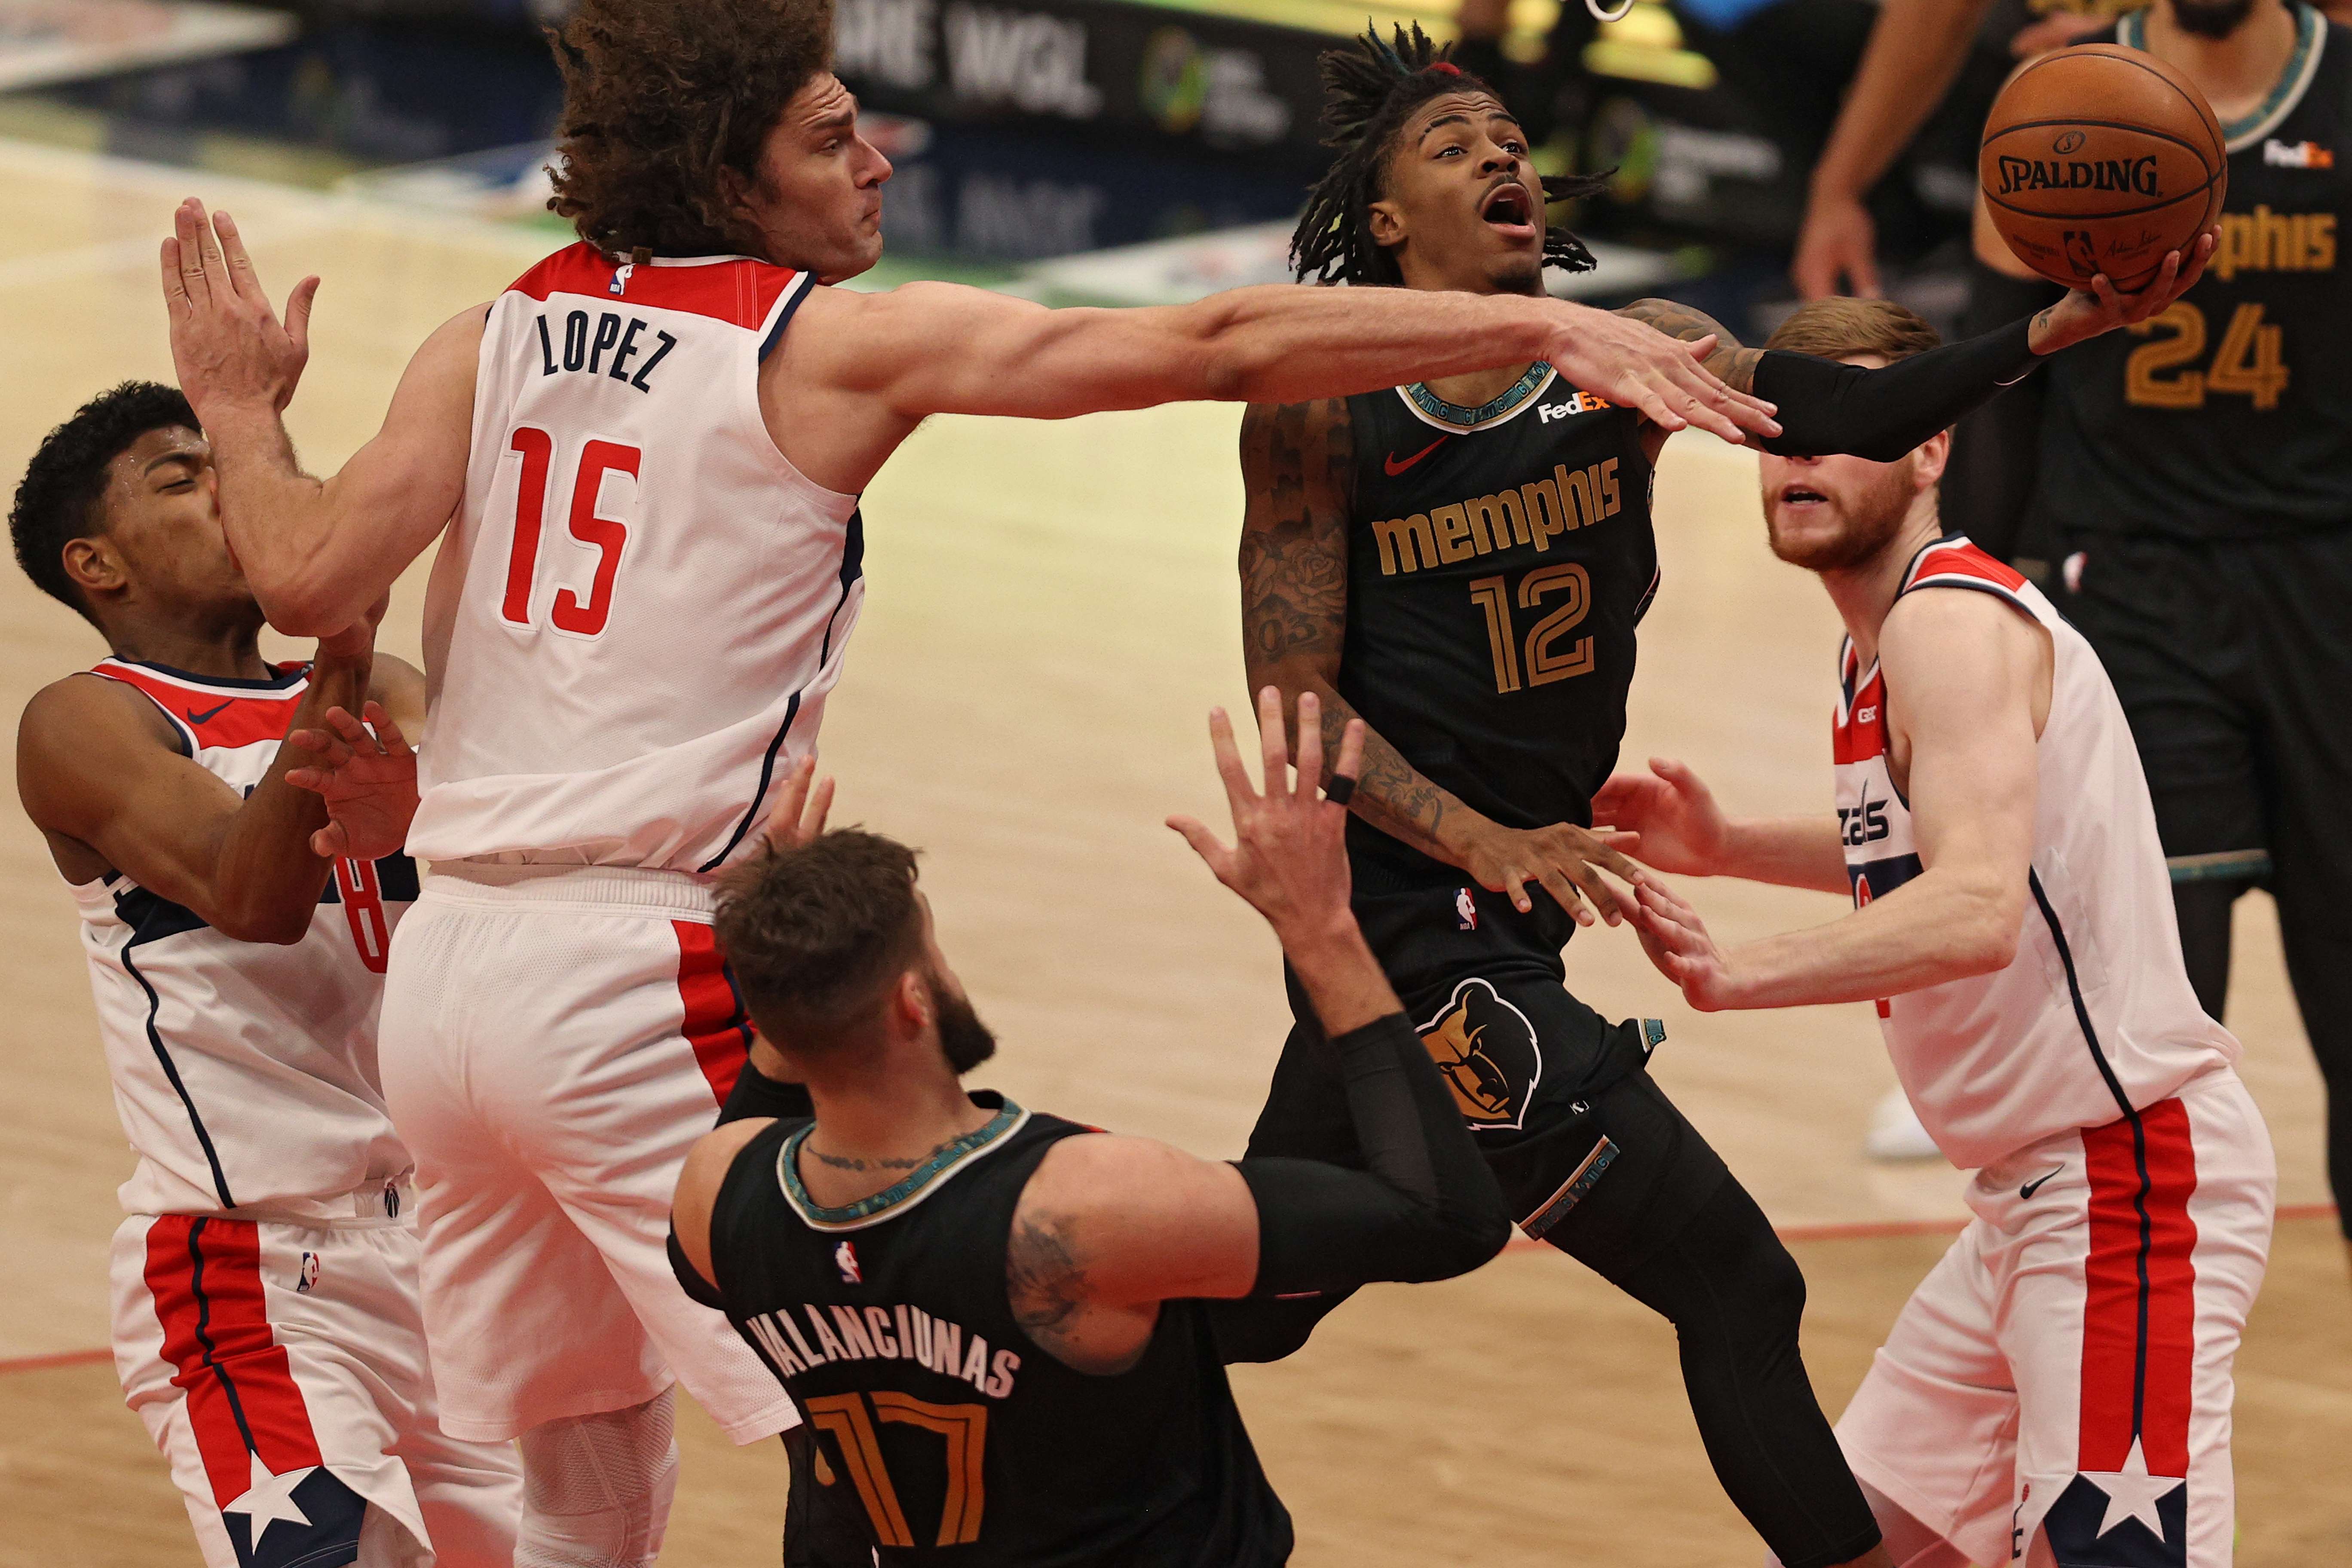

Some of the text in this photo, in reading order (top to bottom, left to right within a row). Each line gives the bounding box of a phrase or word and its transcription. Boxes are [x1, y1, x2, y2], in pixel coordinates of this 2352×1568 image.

[1999, 155, 2158, 197] SPALDING
[537, 309, 677, 393] LOPEZ
[2125, 301, 2290, 410] 24
[1537, 391, 1611, 424] FedEx
[501, 426, 642, 636] 15
[1372, 456, 1620, 575] memphis
[1469, 562, 1594, 694] 12
[746, 1304, 1021, 1399] VALANCIUNAS
